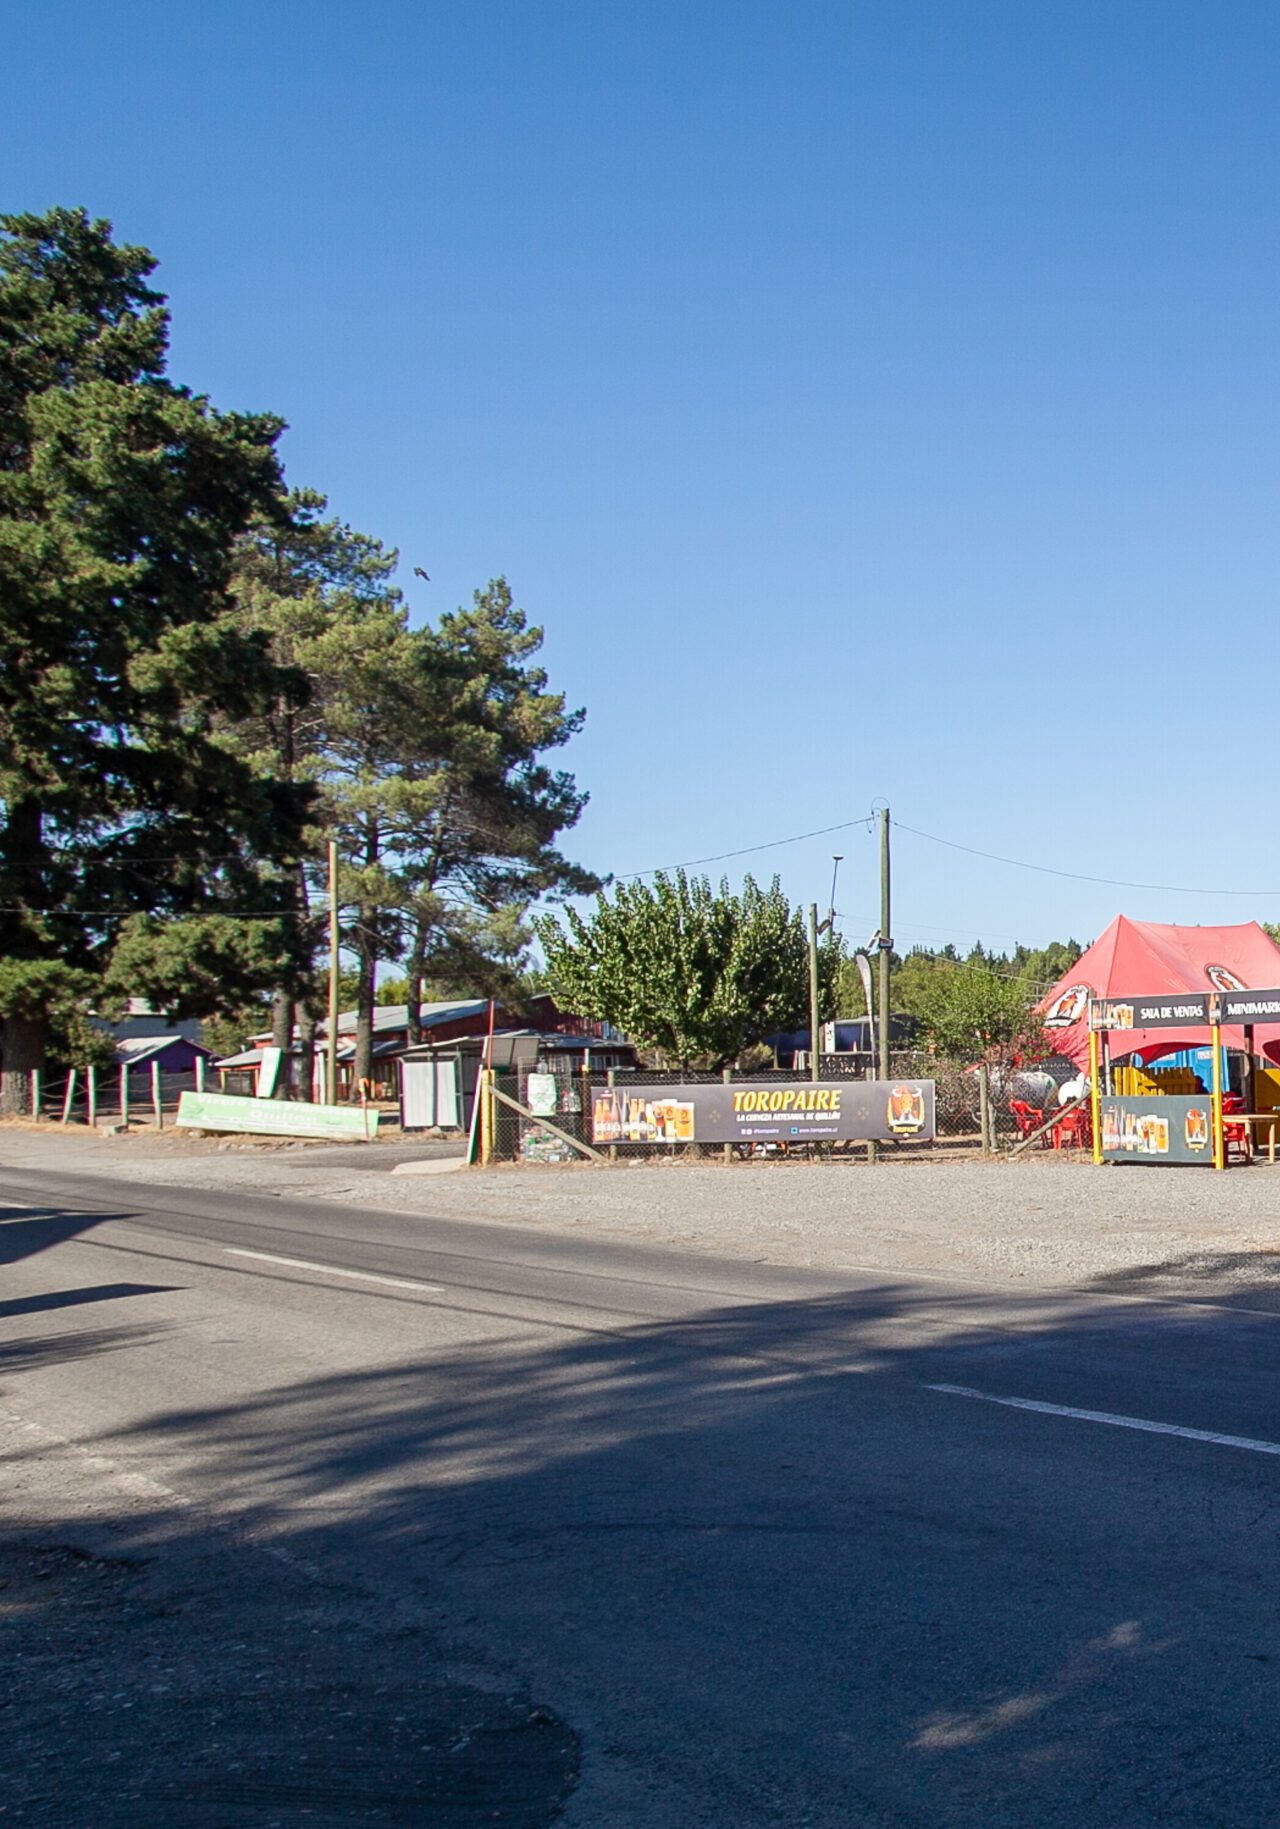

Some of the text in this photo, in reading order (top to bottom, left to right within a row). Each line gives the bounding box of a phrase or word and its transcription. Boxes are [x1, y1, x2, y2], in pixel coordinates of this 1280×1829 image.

[1140, 1005, 1204, 1019] SALA DE VENTAS
[734, 1089, 843, 1112] TOROPAIRE
